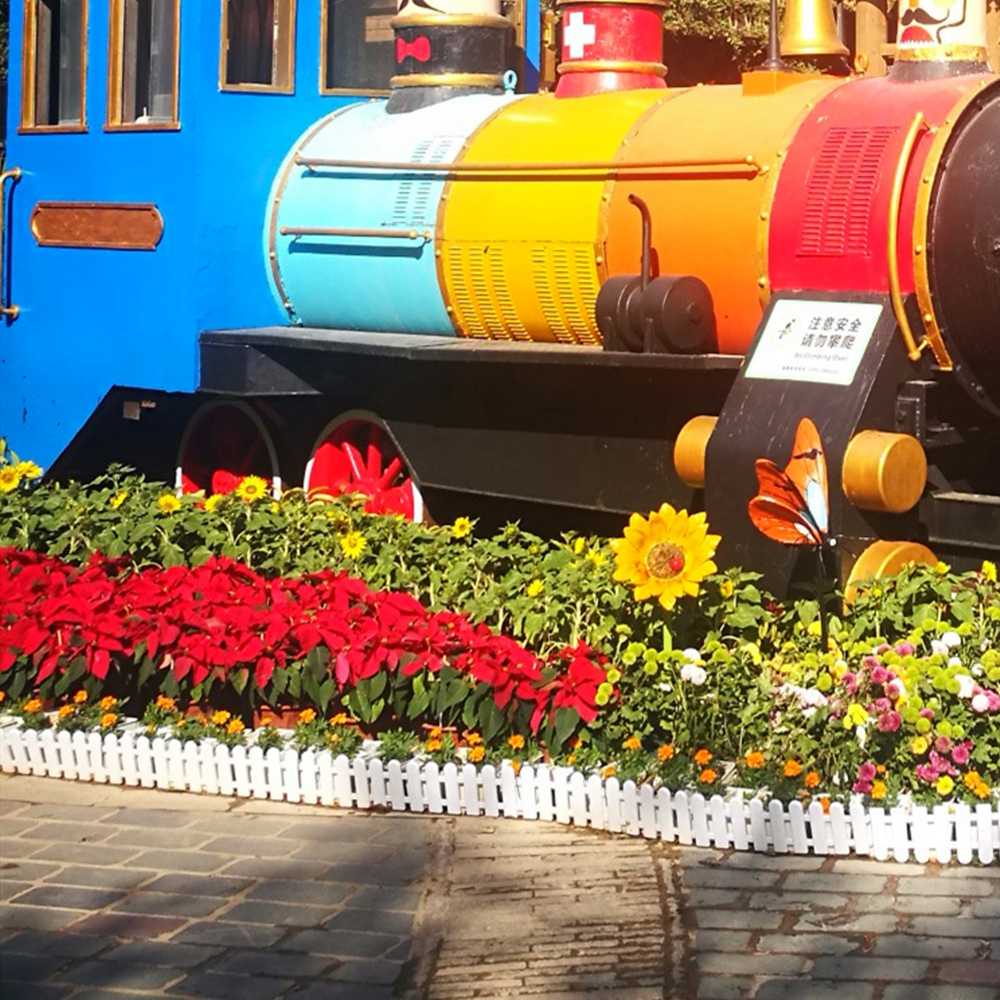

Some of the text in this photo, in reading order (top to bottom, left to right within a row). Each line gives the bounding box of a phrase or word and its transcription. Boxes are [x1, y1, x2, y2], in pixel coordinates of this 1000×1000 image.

[808, 316, 862, 333] 注意安全
[800, 333, 856, 350] 请勿攀爬
